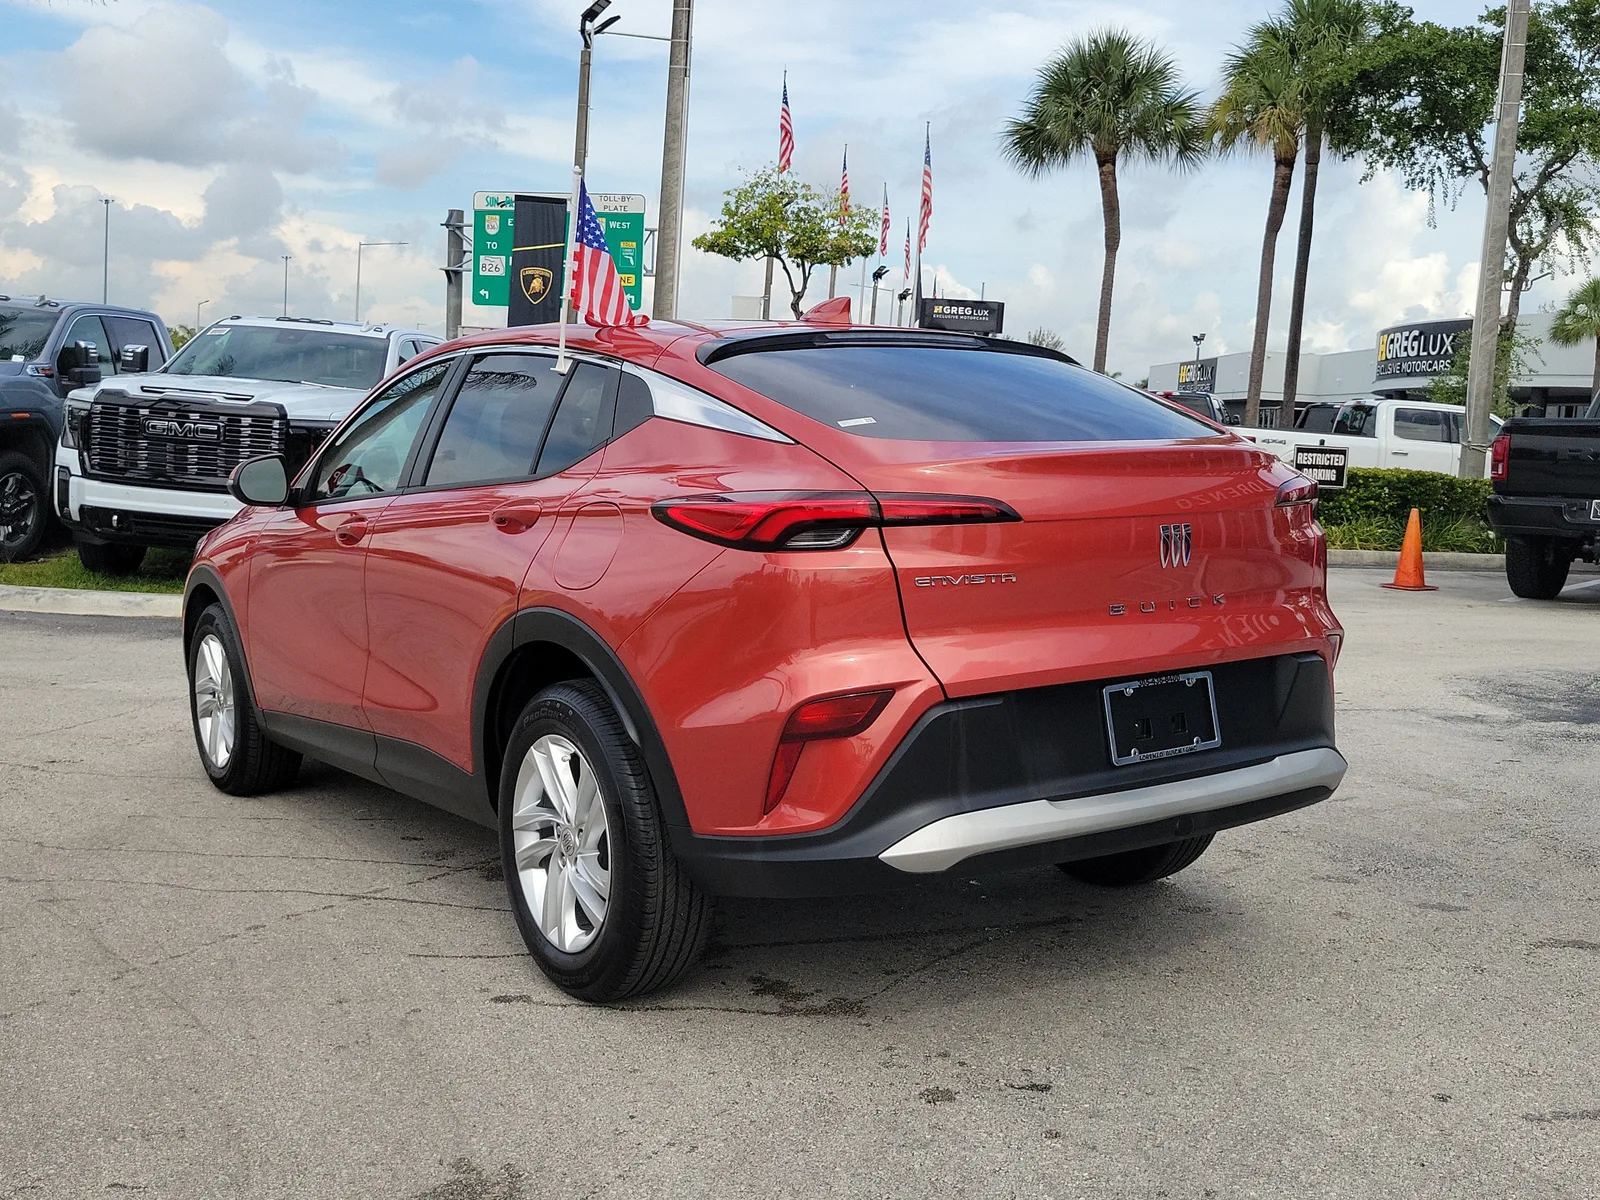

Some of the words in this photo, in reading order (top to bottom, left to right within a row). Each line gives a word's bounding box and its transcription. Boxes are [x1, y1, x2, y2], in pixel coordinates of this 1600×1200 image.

[599, 195, 634, 203] TOLL-BY-
[609, 221, 631, 229] WEST
[486, 241, 498, 249] TO
[481, 263, 501, 272] 826
[1401, 360, 1451, 373] MOTORCARS
[145, 420, 218, 439] GMC
[1297, 452, 1345, 466] RESTRICTED
[1303, 468, 1337, 481] PARKING
[914, 572, 1017, 588] ENVISTA
[1108, 593, 1227, 616] BUICK
